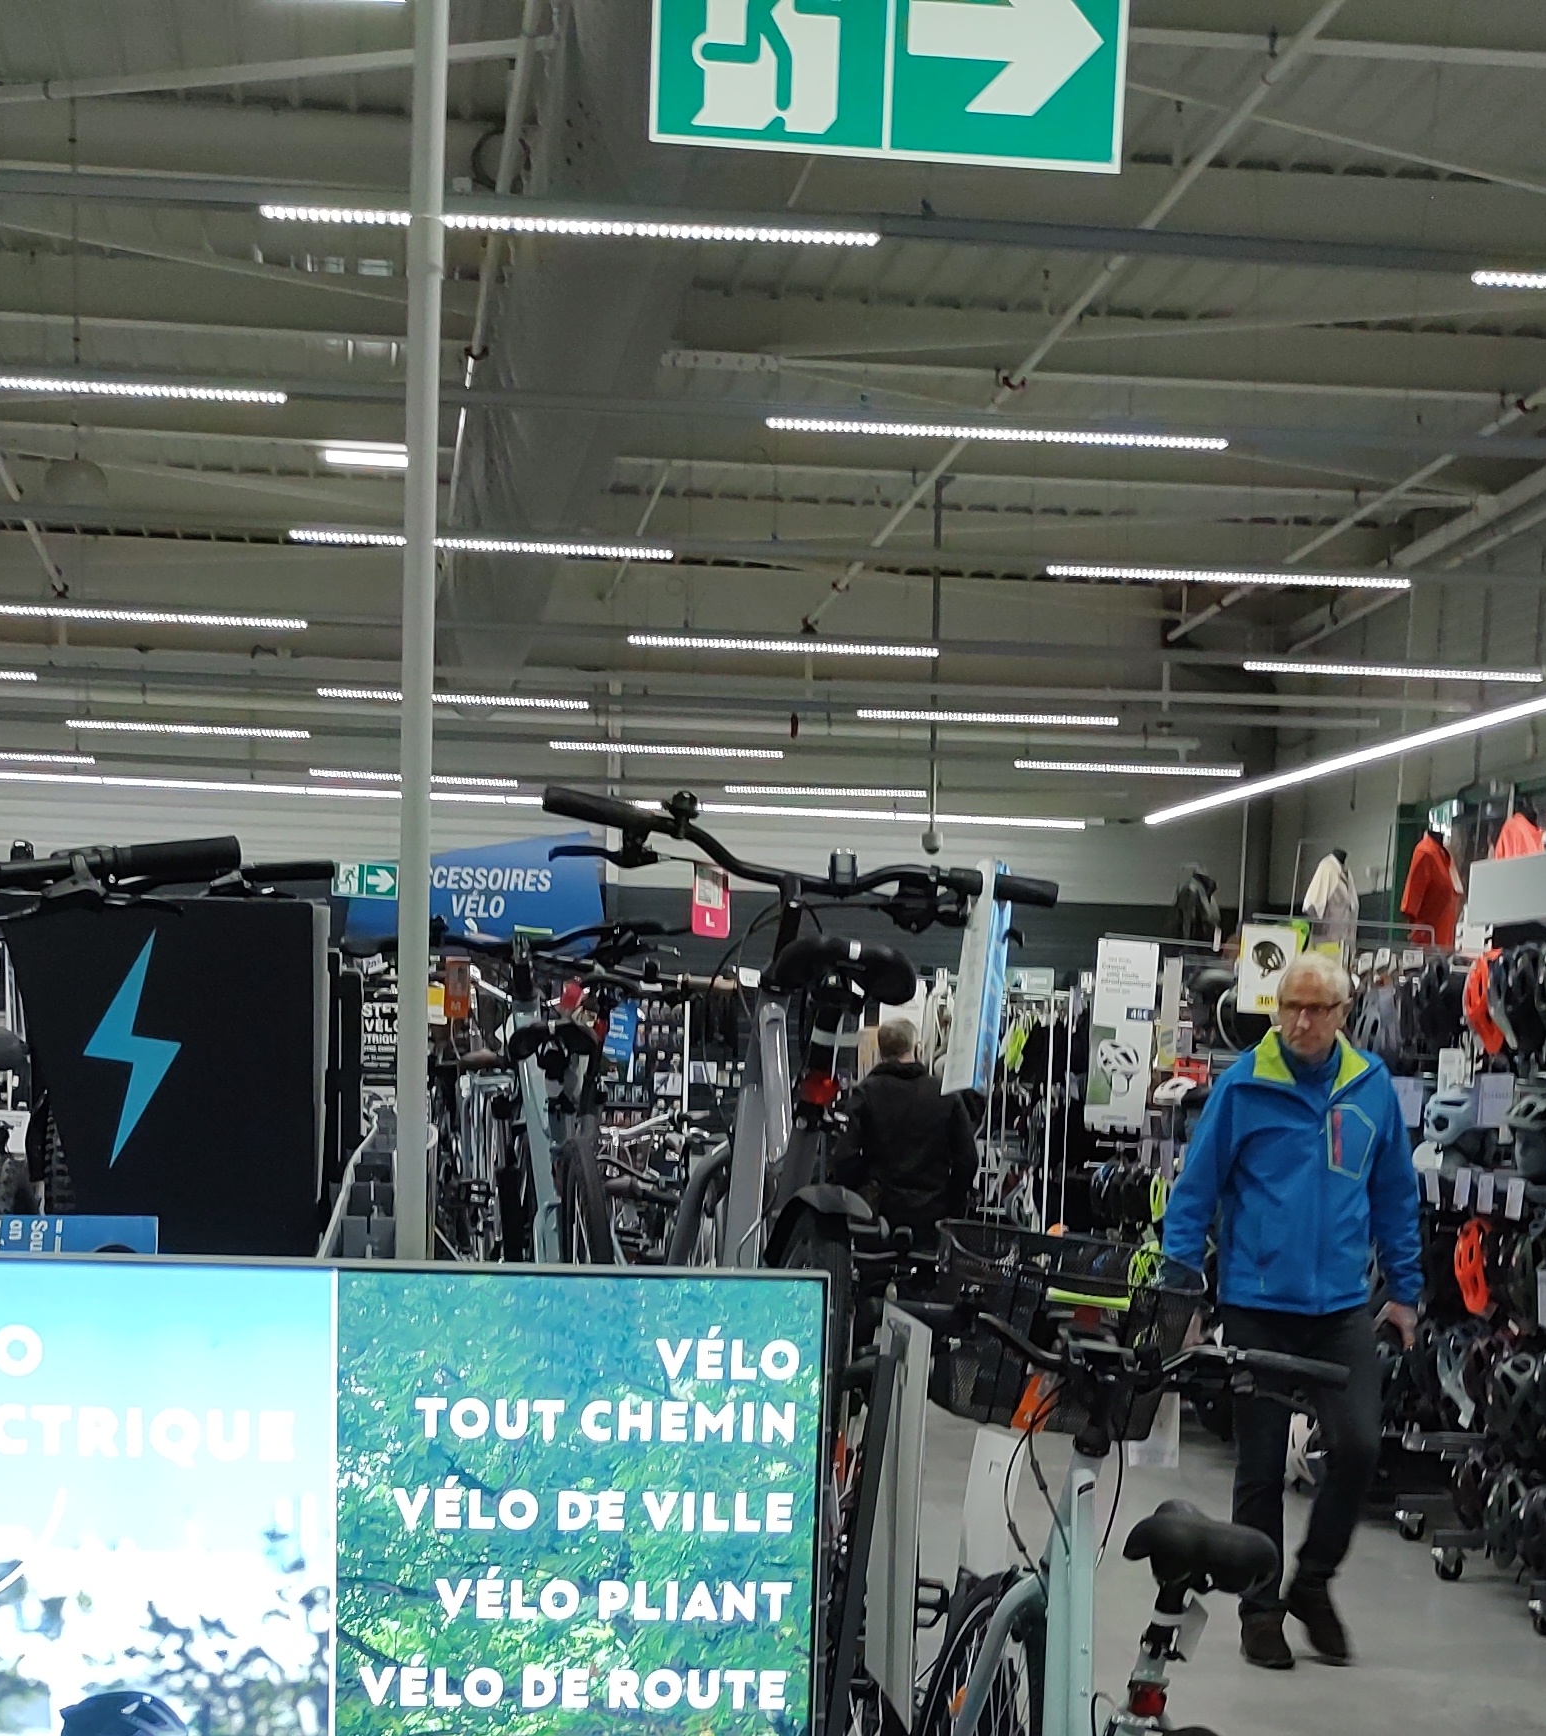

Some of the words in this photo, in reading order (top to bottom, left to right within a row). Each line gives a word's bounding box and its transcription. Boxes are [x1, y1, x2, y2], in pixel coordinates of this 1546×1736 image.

[429, 865, 552, 893] CESSOIRES
[452, 889, 505, 918] VÉLO
[705, 910, 716, 928] L
[655, 1325, 801, 1381] VÉLO
[415, 1397, 565, 1441] TOUT
[580, 1400, 797, 1443] CHEMIN
[392, 1474, 540, 1530] VÉLO
[557, 1490, 626, 1531] DE
[642, 1491, 794, 1533] VILLE
[434, 1565, 580, 1621] VÉLO
[598, 1580, 793, 1622] PLIANT
[359, 1653, 504, 1708] VÉLO
[522, 1668, 591, 1709] DE
[609, 1669, 787, 1711] ROUTE
